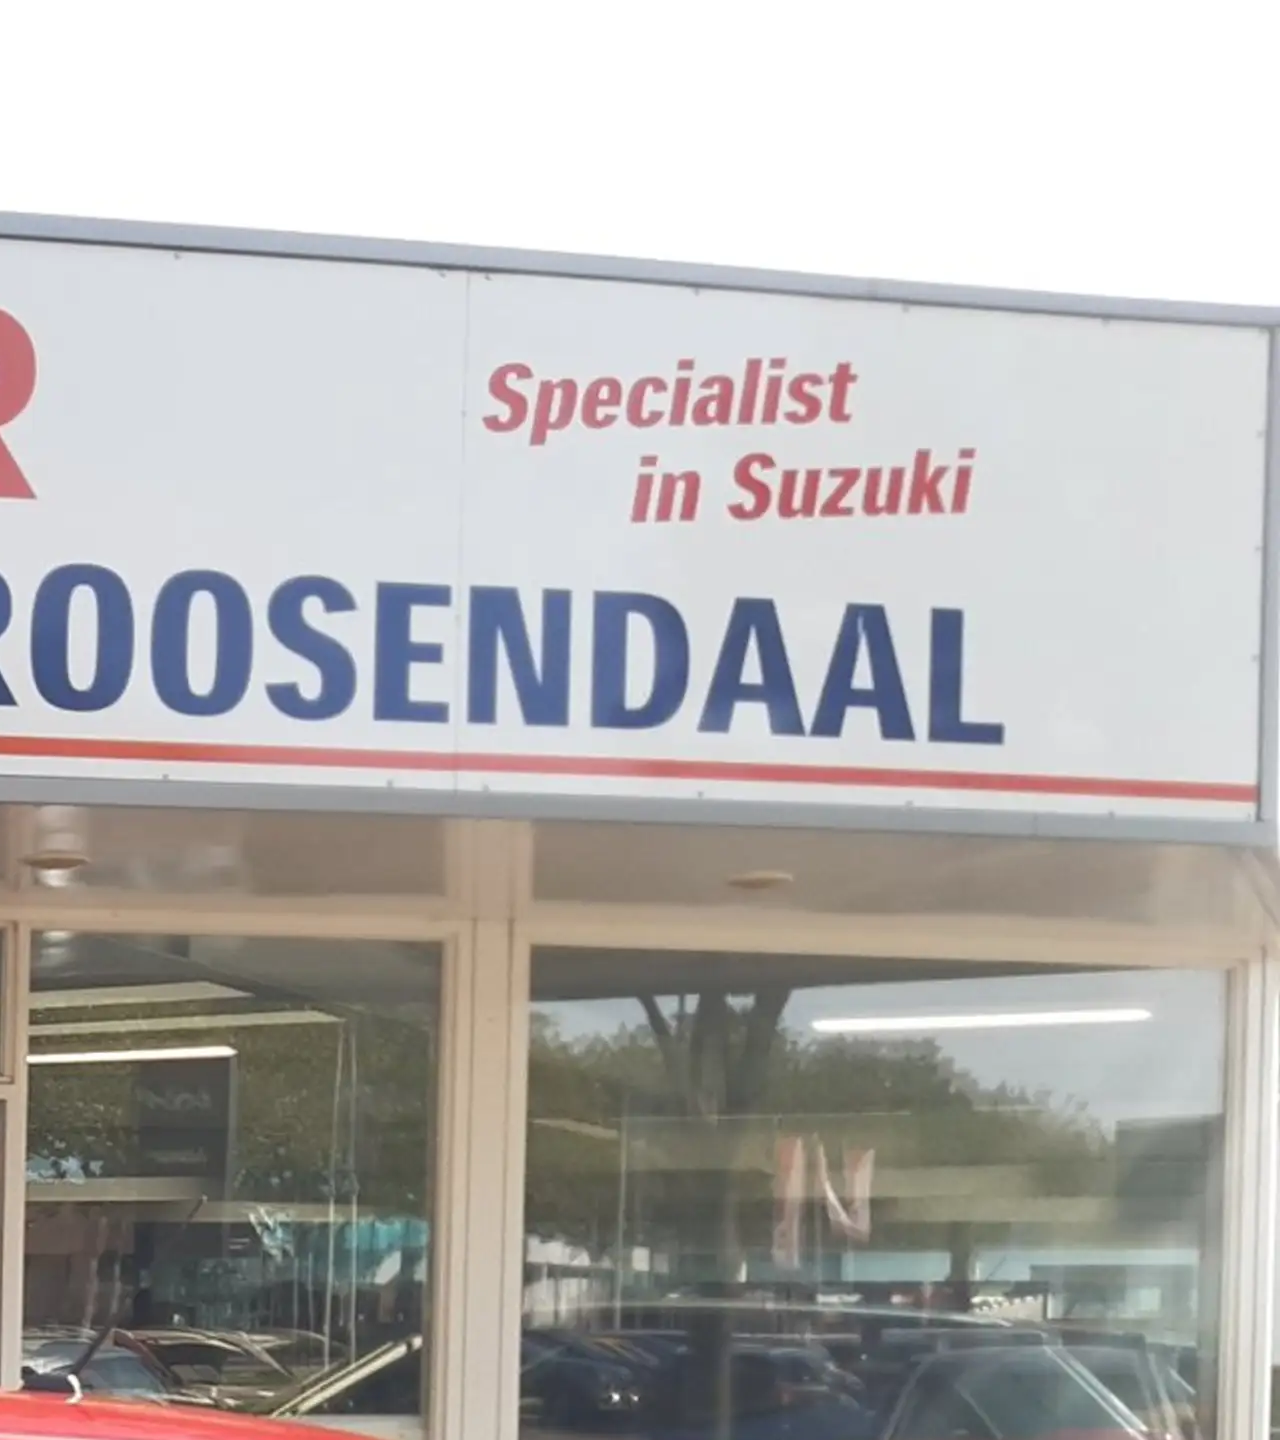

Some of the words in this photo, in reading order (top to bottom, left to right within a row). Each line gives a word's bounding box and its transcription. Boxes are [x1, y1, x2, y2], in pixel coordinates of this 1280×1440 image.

[482, 356, 858, 446] Specialist
[629, 455, 702, 523] in
[727, 448, 976, 521] Suzuki
